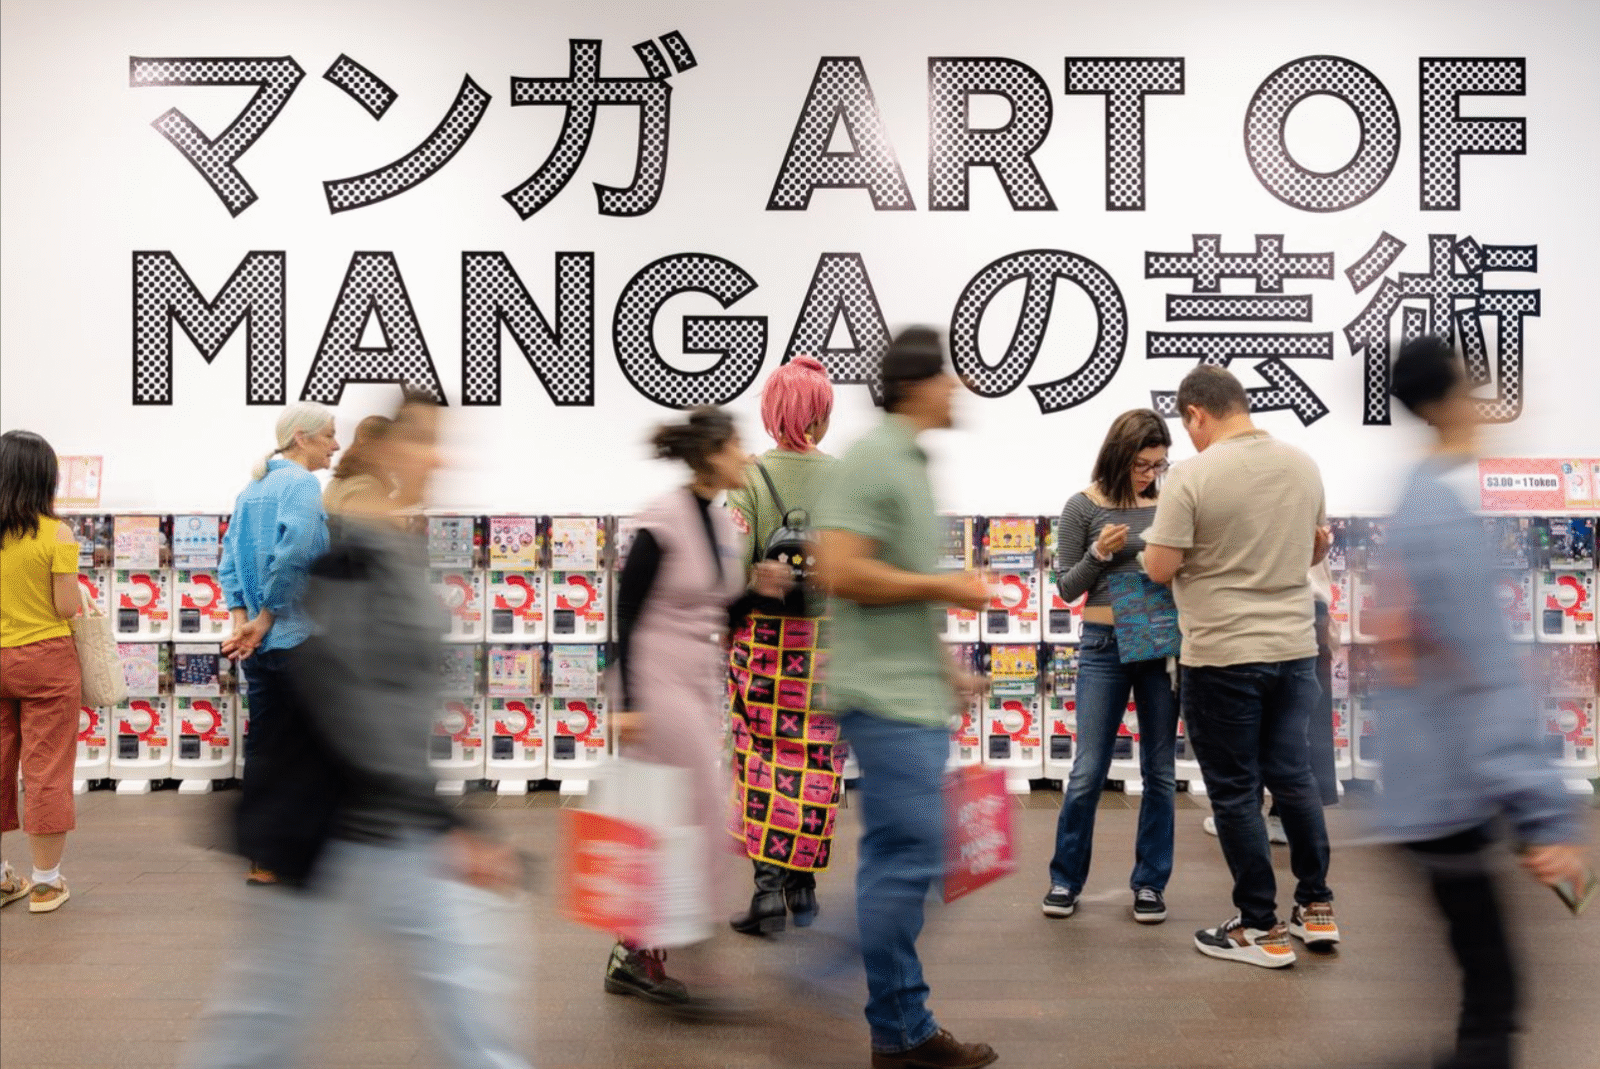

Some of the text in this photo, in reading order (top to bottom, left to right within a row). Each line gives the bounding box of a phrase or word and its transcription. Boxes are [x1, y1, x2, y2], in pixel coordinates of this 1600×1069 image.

[130, 30, 1527, 218] マンガ ART OF
[1486, 476, 1513, 488] $3.00
